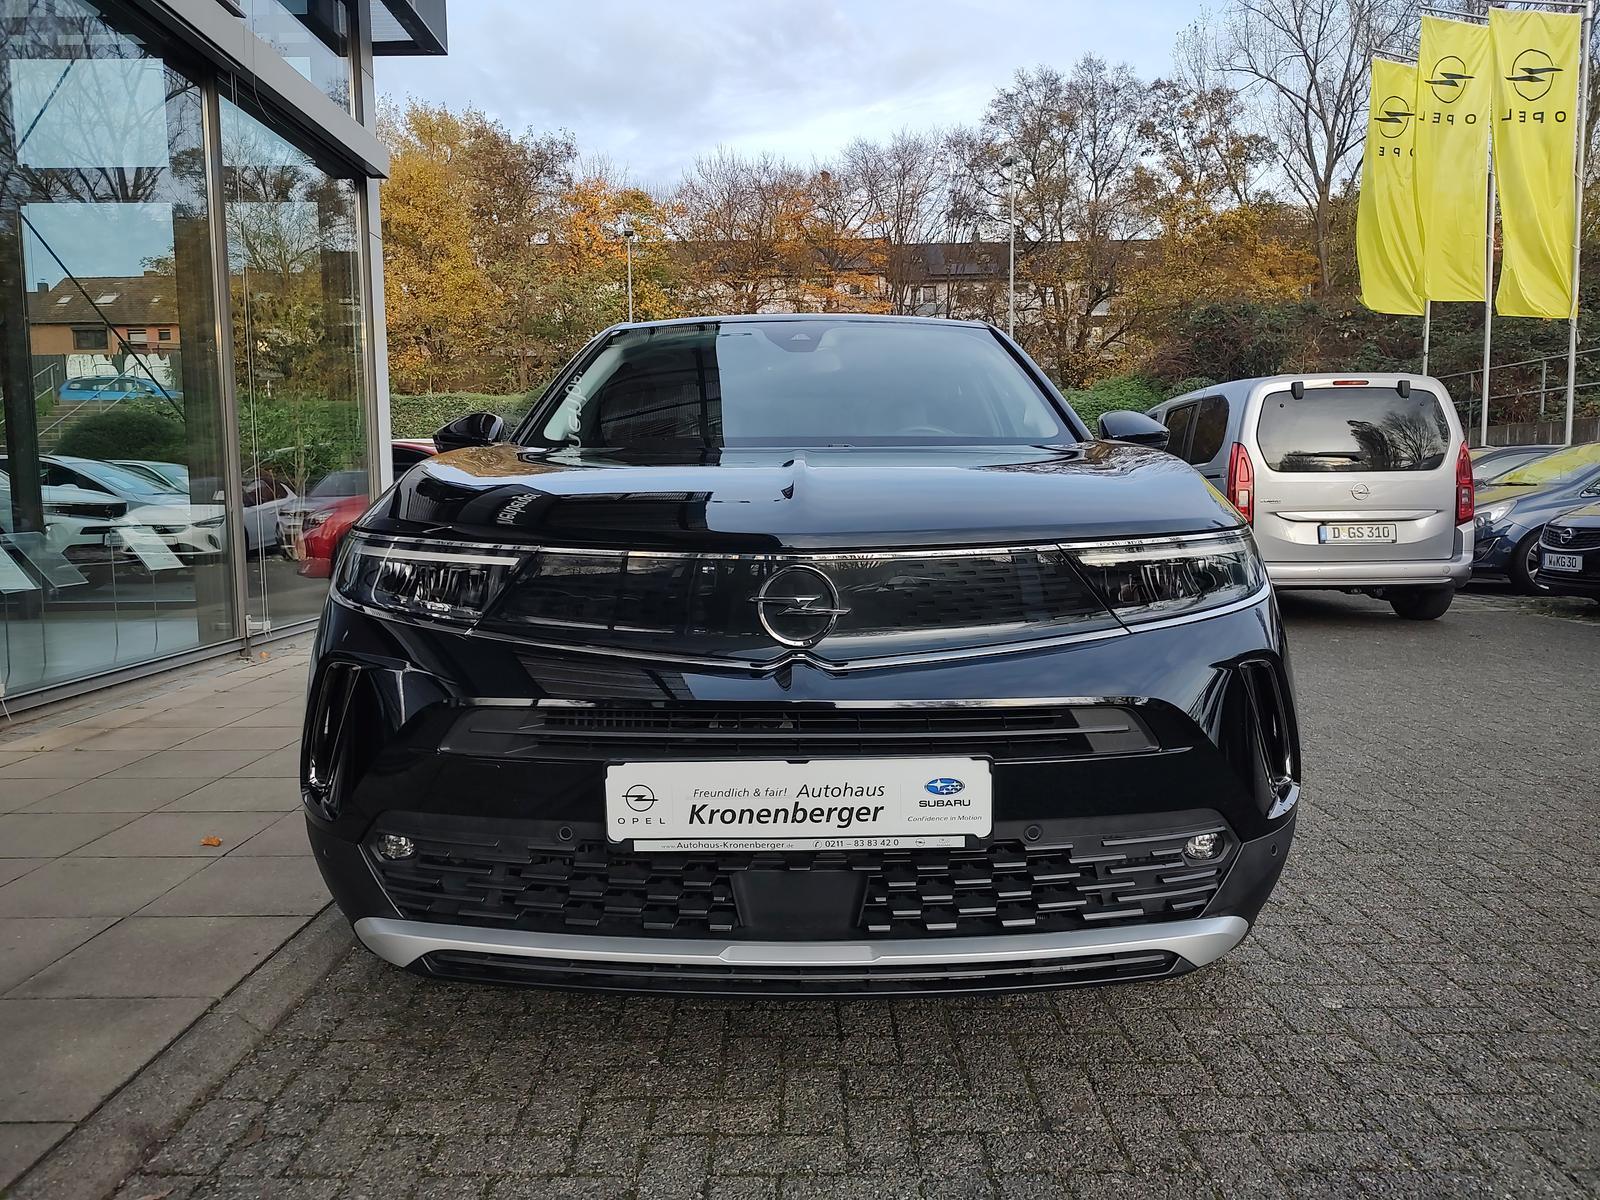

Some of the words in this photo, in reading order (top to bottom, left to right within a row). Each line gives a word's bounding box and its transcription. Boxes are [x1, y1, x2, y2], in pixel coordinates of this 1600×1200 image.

[1332, 526, 1341, 539] D
[1347, 526, 1364, 539] GS
[1367, 526, 1390, 539] 310
[693, 788, 750, 798] Freundlich
[753, 788, 761, 797] &
[765, 787, 788, 797] fair!
[796, 782, 885, 798] Autohaus
[918, 799, 971, 808] SUBARU
[688, 801, 885, 829] Kronenberger
[617, 817, 666, 825] OPEL
[880, 839, 892, 847] 42
